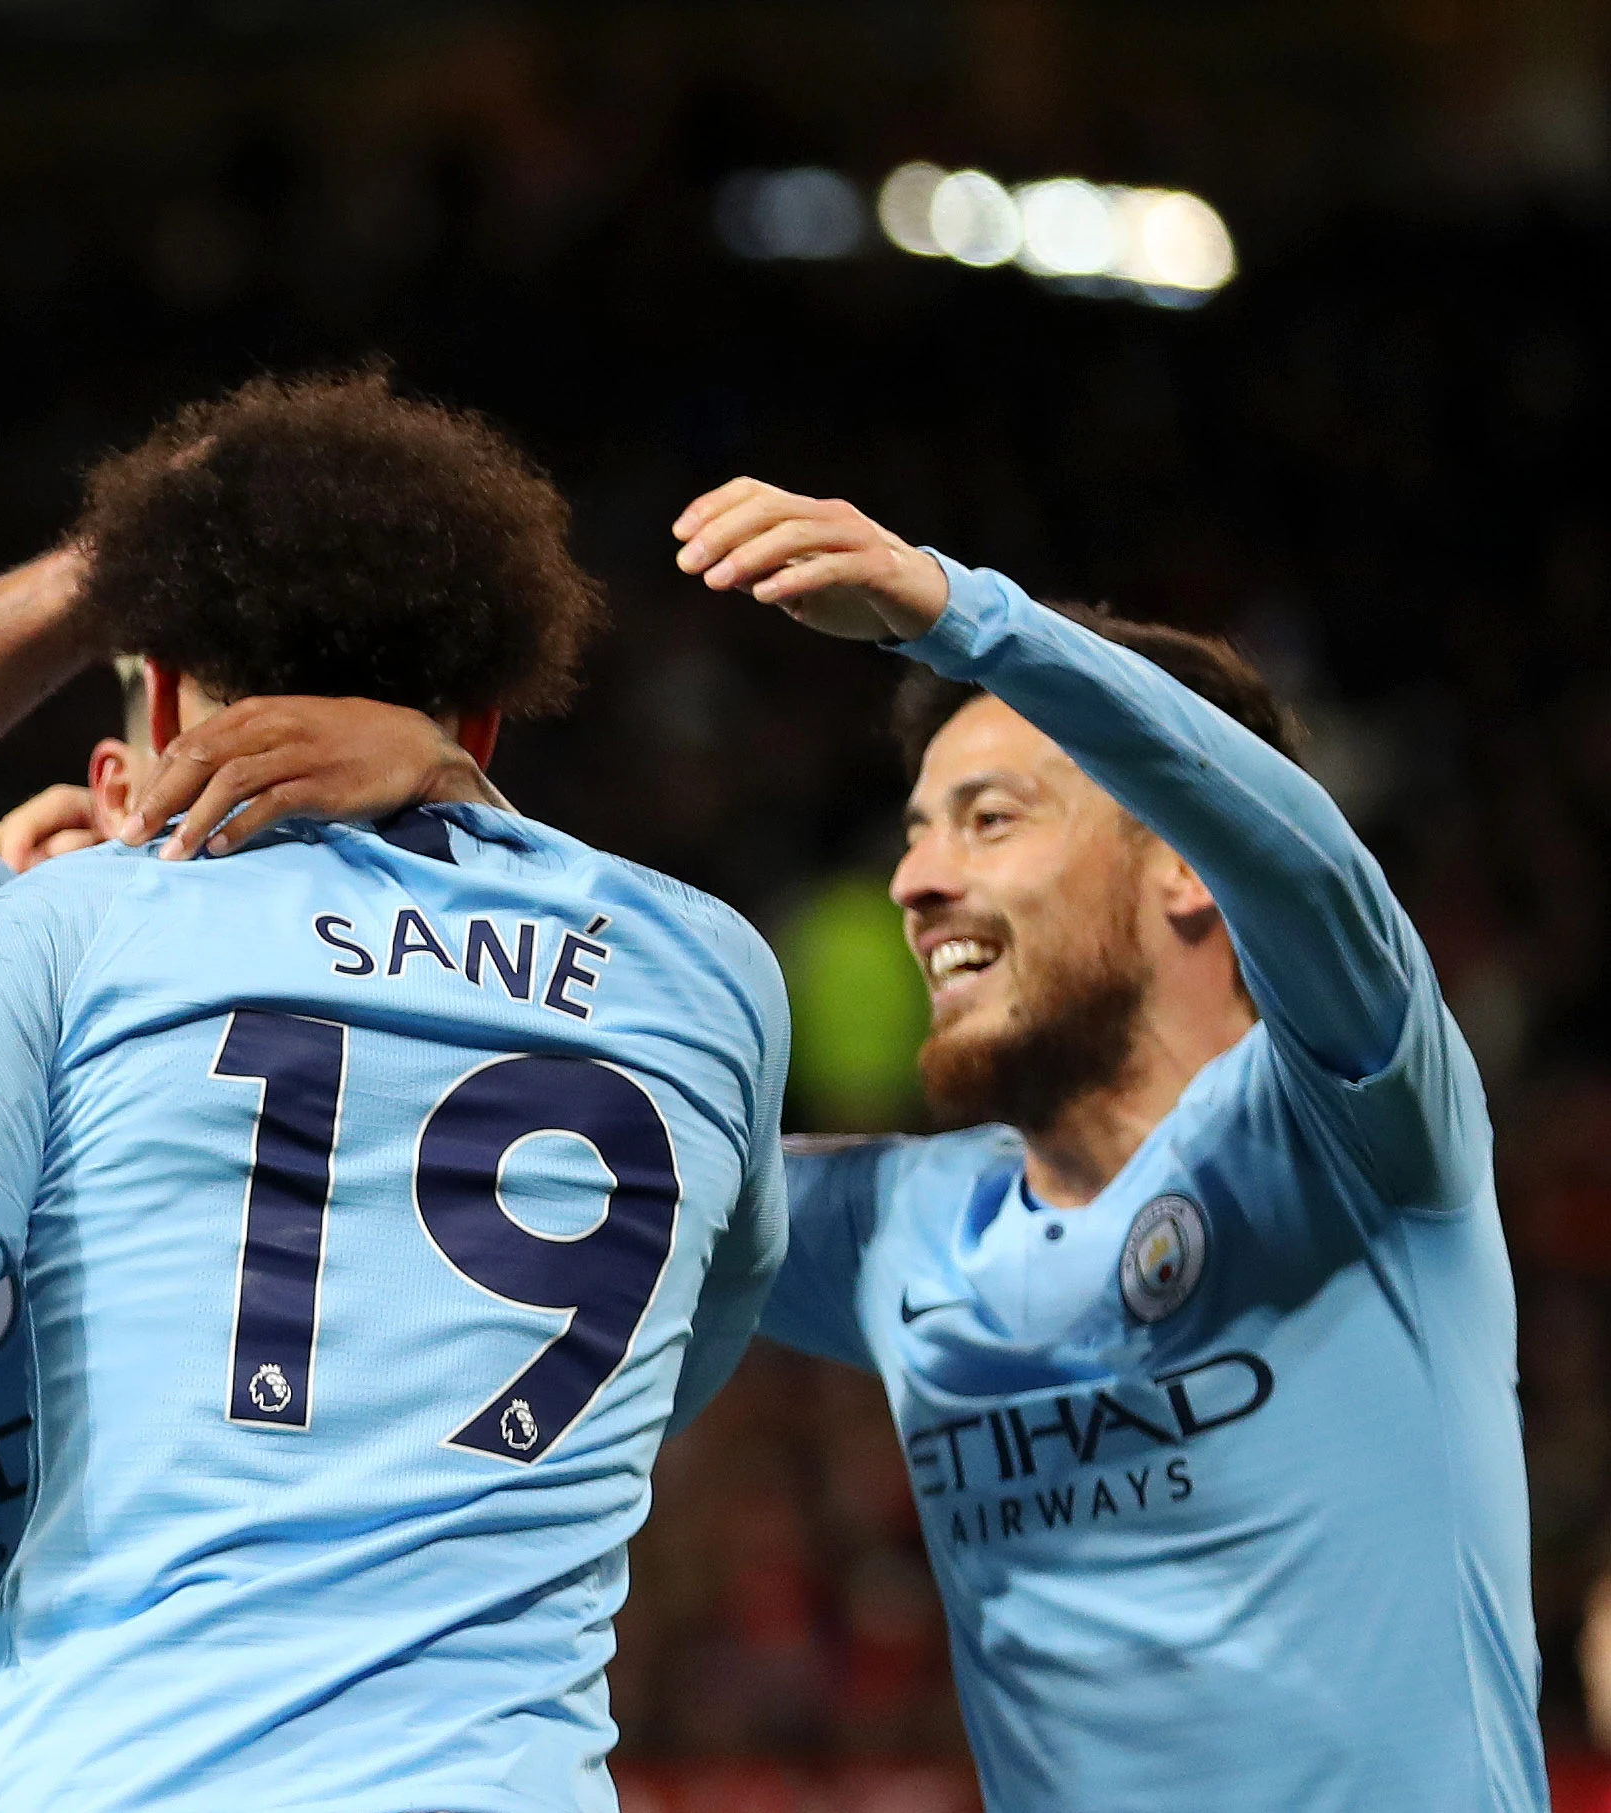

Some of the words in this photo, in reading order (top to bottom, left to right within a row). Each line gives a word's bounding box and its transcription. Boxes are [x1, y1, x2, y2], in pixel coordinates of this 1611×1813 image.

[311, 905, 611, 1023] SANÉ
[207, 1006, 683, 1468] 19
[906, 1351, 1276, 1497] ETIHAD
[950, 1457, 1193, 1543] AIRWAYS
